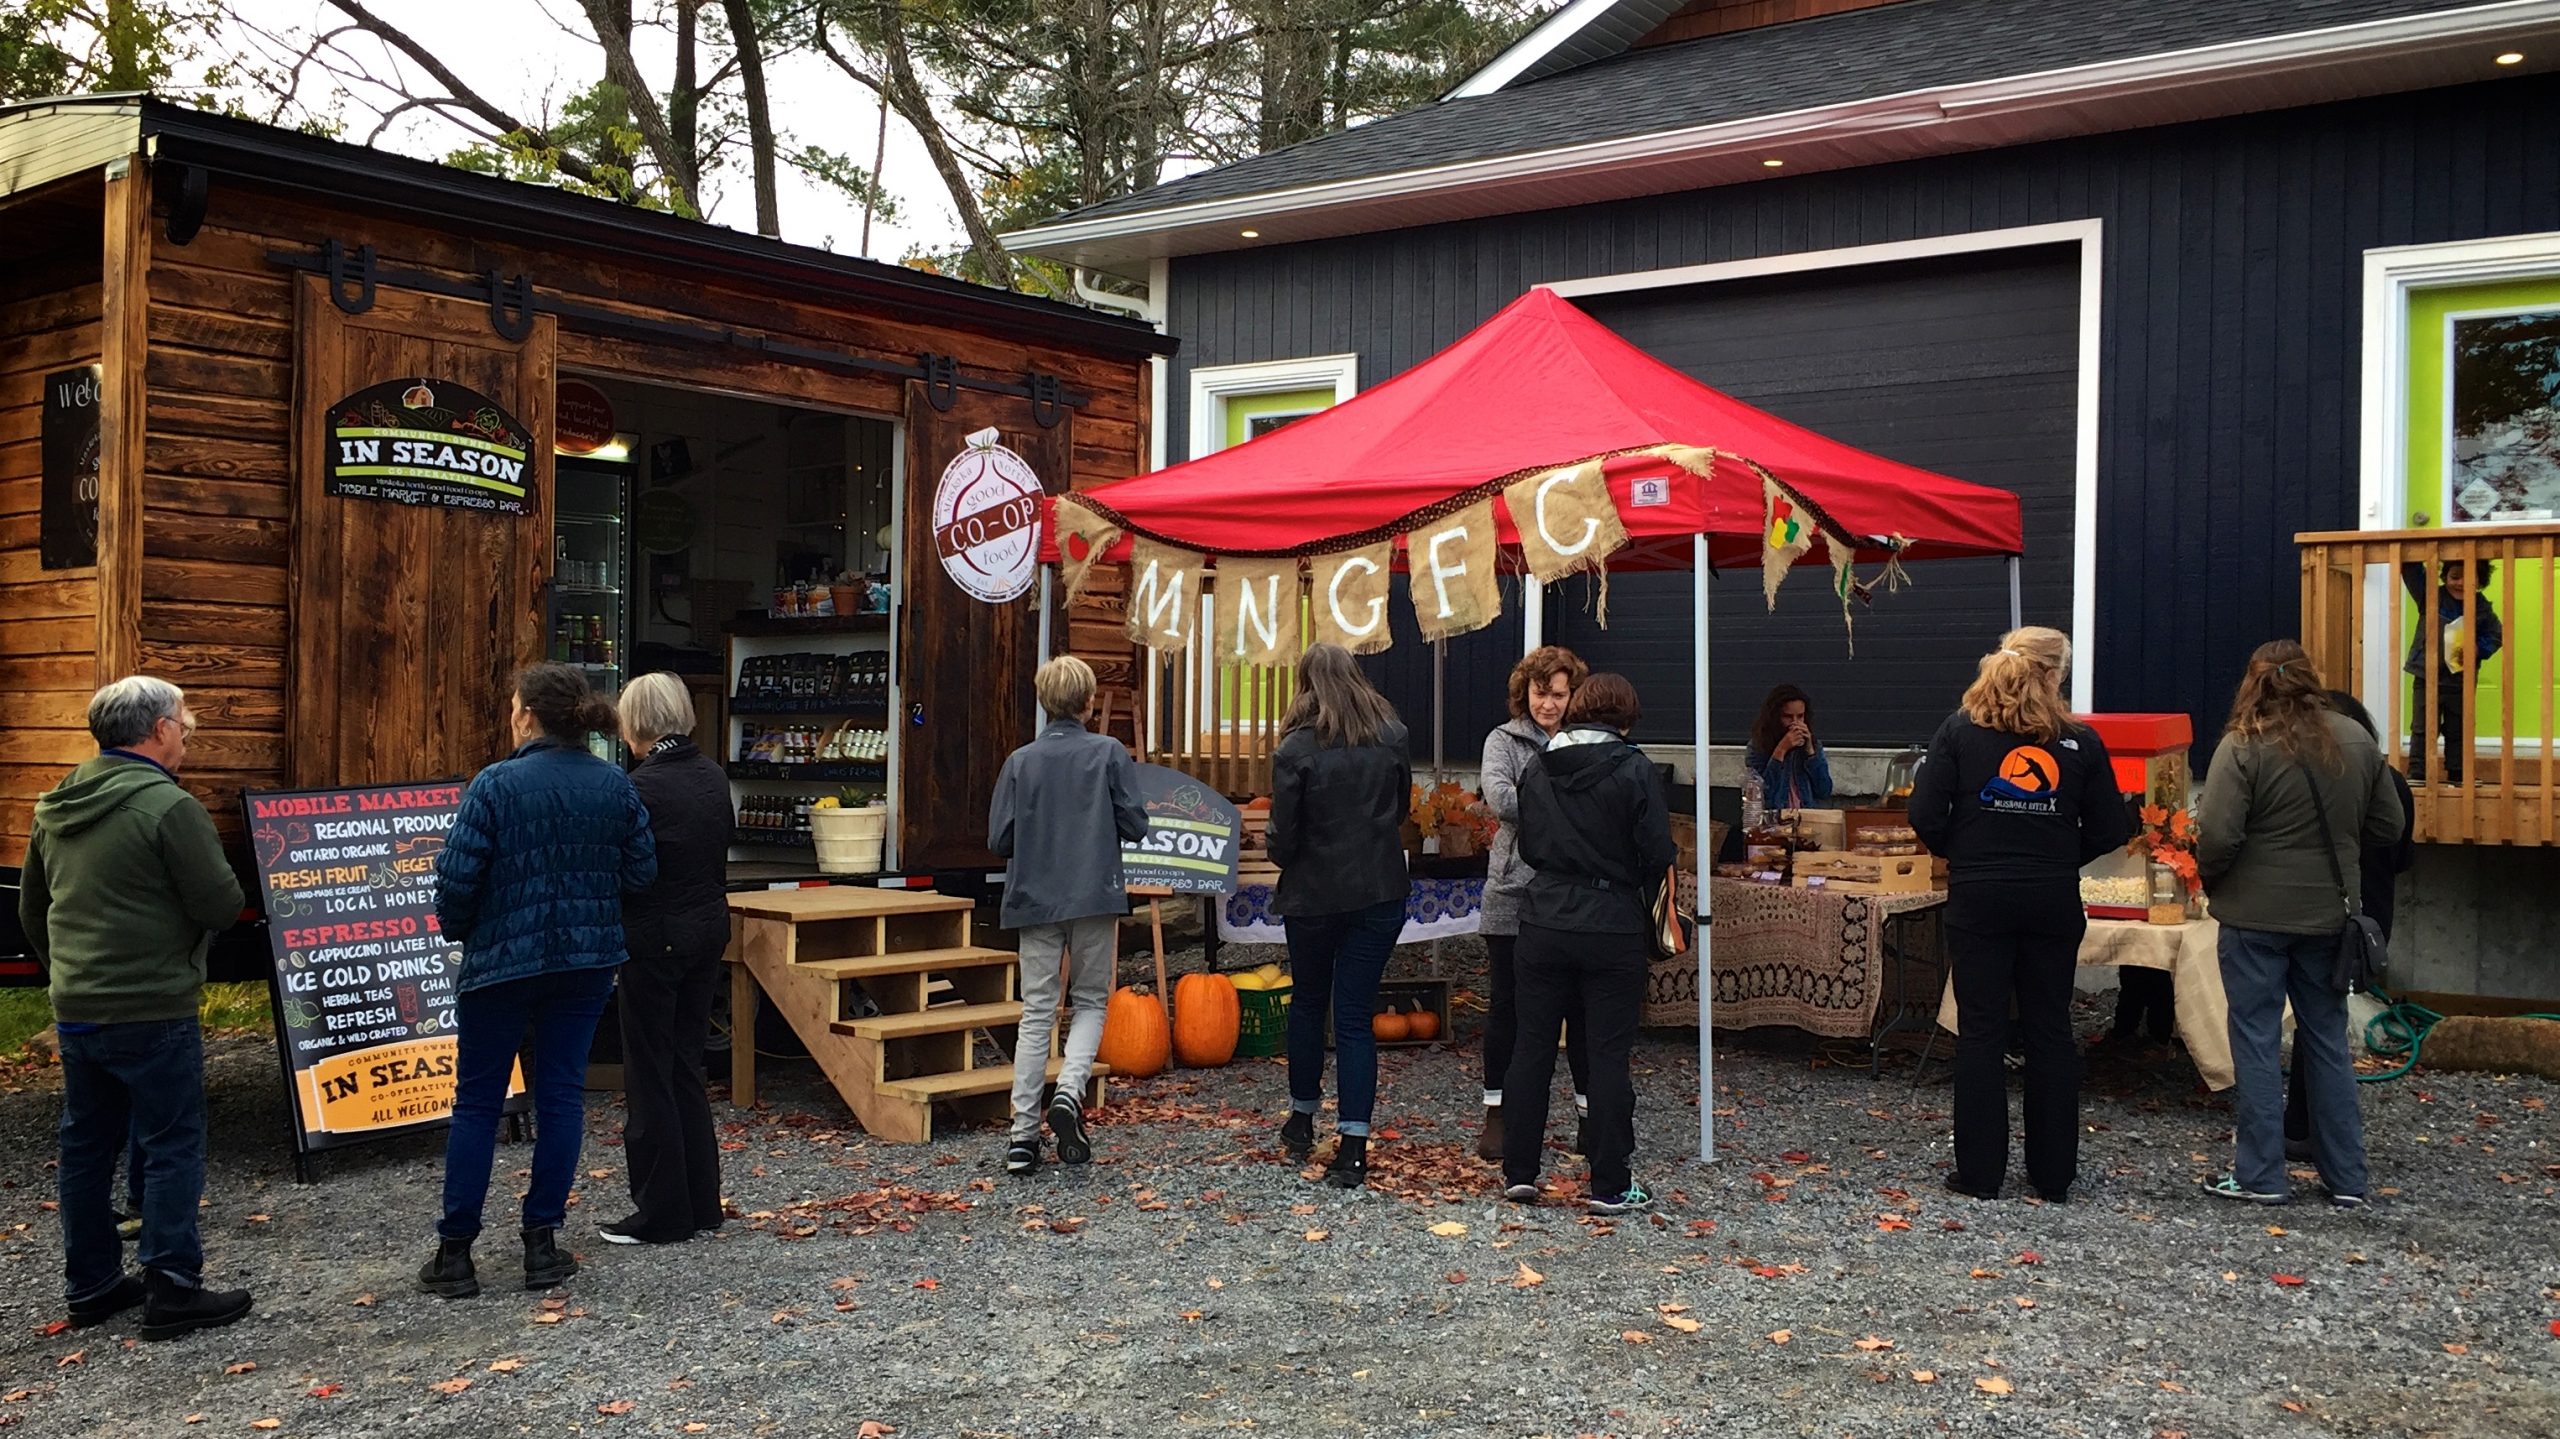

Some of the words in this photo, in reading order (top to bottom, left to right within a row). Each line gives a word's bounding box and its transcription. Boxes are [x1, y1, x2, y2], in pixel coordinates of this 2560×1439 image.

[340, 440, 381, 464] IN
[392, 441, 524, 483] SEASON
[339, 482, 378, 497] MOBILE
[382, 487, 428, 504] MARKET
[443, 494, 496, 509] ESPRESSO
[499, 500, 524, 515] BAR
[966, 482, 1006, 511] good
[982, 540, 1019, 566] food
[254, 795, 351, 818] MOBILE
[359, 787, 461, 811] MARKET
[314, 818, 390, 841] REGIONAL
[290, 846, 340, 863] ONTARIO
[342, 843, 390, 858] ORGANIC
[268, 869, 322, 890] FRESH
[325, 865, 368, 884] FRUIT
[1197, 880, 1226, 893] BAR
[293, 888, 333, 900] HAND-MADE
[334, 887, 346, 896] ICE
[347, 885, 371, 895] CREAM
[326, 896, 377, 914] LOCAL
[385, 889, 438, 908] HONEY
[283, 915, 417, 948] ESPRESSO
[309, 943, 382, 964] CAPPUCCINO
[286, 972, 318, 992] ICE
[322, 965, 372, 988] COLD
[377, 954, 445, 981] DRINKS
[323, 993, 363, 1008] HERBAL
[364, 987, 394, 1002] TEAS
[421, 977, 451, 993] CHAI
[326, 1007, 397, 1031] REFRESH
[298, 1036, 336, 1051] ORGANIC
[338, 1034, 346, 1045] &
[347, 1031, 368, 1044] WILD
[369, 1026, 408, 1041] CRAFTED
[348, 1046, 417, 1067] COMMUNITY
[423, 1042, 457, 1052] OWNE
[320, 1071, 359, 1104] IN
[370, 1055, 458, 1088] SEAS
[370, 1081, 455, 1102] CO-OPERATIVE
[372, 1109, 393, 1124] ALL
